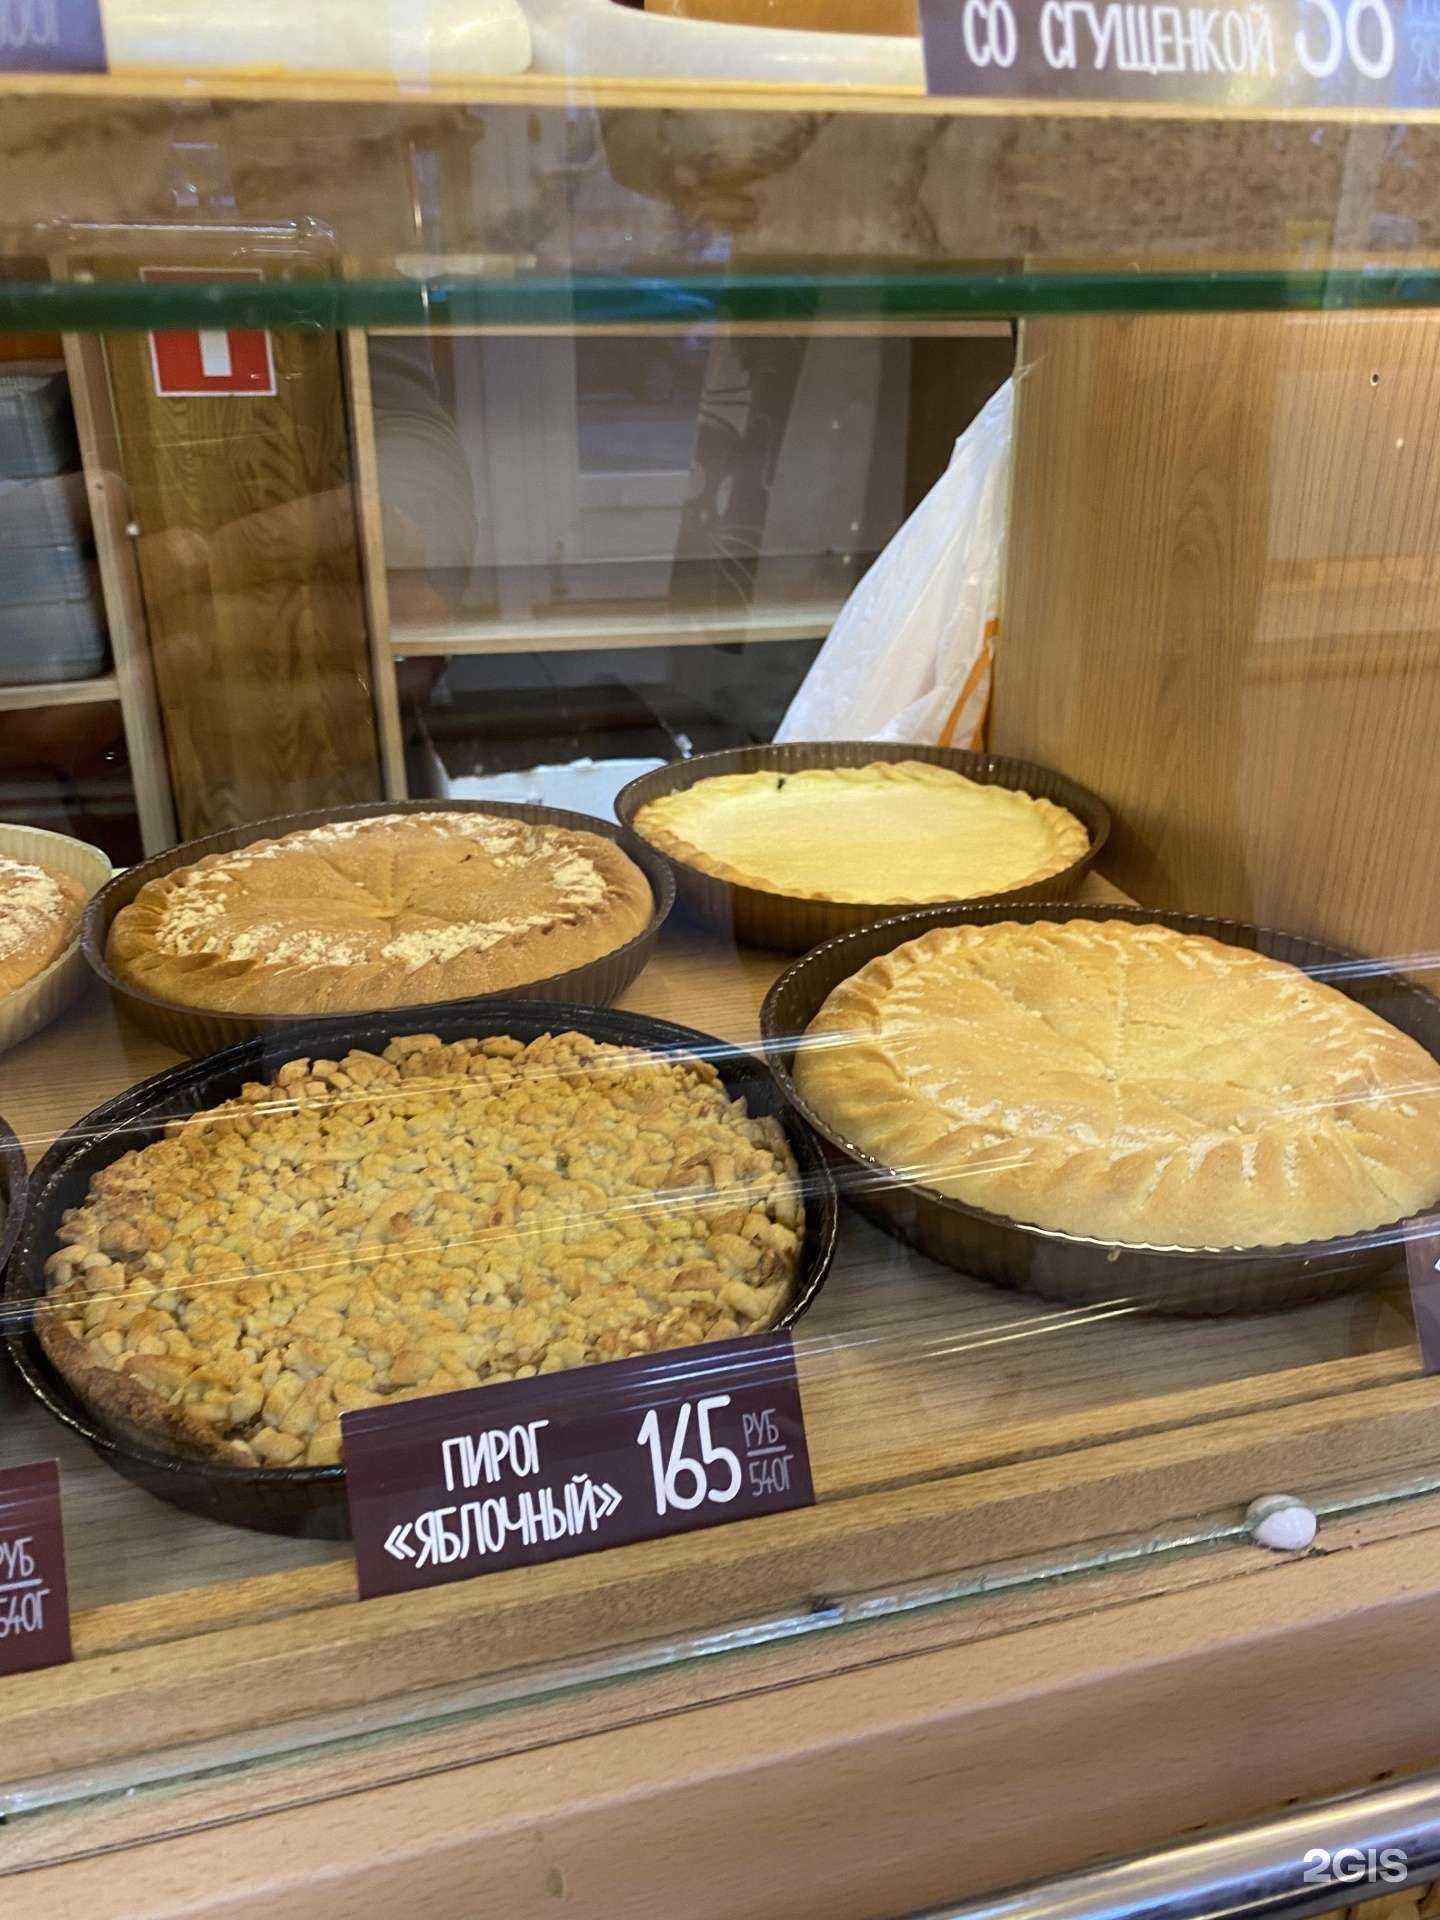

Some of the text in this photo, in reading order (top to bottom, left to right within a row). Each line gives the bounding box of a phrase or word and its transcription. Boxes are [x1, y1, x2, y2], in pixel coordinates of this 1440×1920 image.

[962, 0, 1277, 76] СО СГУЩЕНКОЙ
[442, 1419, 549, 1492] ПИРОГ
[637, 1394, 742, 1516] 165
[742, 1408, 779, 1449] РУБ
[749, 1454, 794, 1496] 540Г
[383, 1474, 623, 1569] «ЯБЛОЧНЫЙ»
